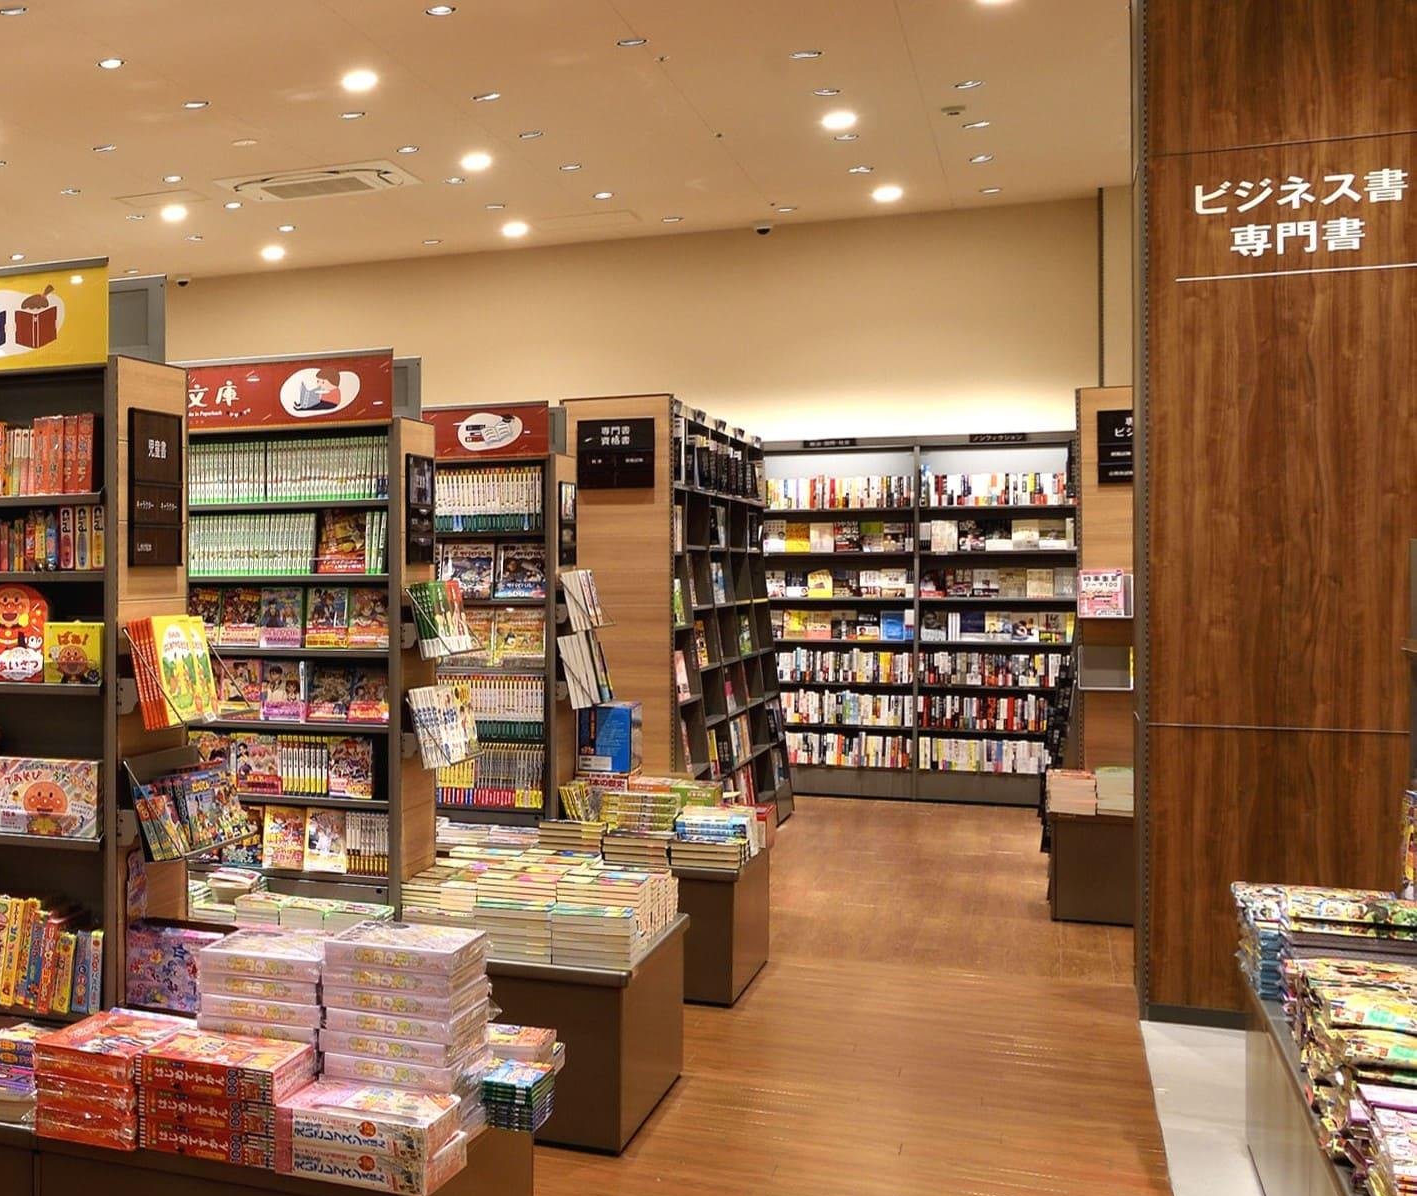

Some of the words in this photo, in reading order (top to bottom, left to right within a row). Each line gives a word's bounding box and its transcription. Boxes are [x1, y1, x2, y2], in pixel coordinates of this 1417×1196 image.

[1194, 168, 1409, 215] ビジネス書
[1230, 217, 1366, 257] 専門書
